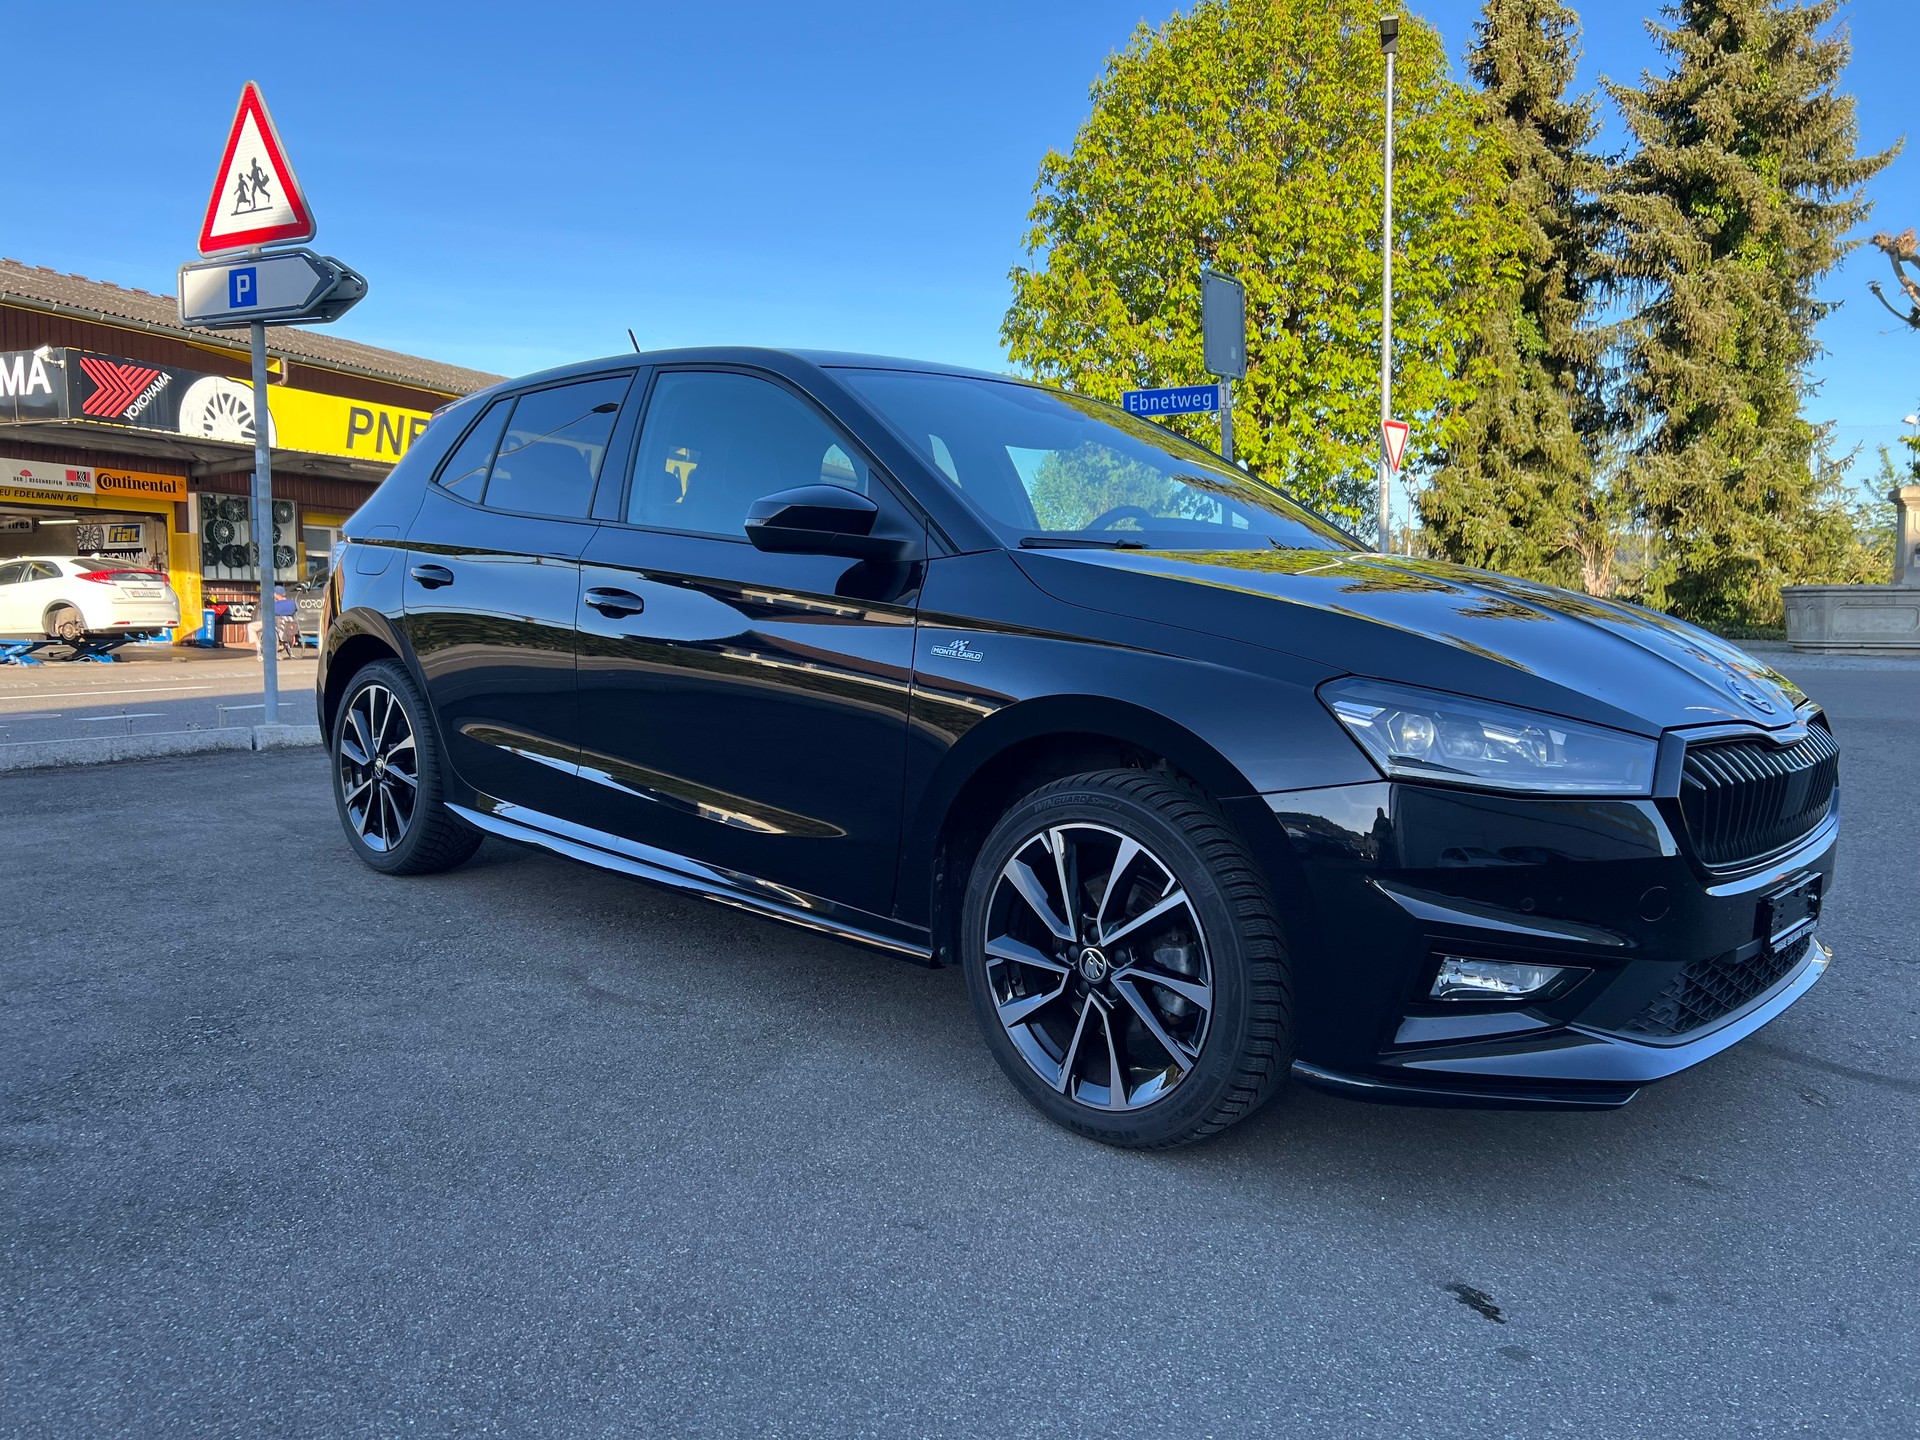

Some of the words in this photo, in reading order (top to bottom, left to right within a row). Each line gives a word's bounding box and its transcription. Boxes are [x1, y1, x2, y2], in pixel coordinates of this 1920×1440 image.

[236, 274, 250, 303] P
[0, 355, 52, 397] MA
[123, 371, 172, 421] YOKOHAMA
[1130, 392, 1212, 412] Ebnetweg
[97, 473, 177, 493] Continental
[14, 489, 64, 501] EDELMANN
[66, 494, 79, 502] AG
[933, 647, 957, 656] MONTE
[957, 651, 981, 660] CARLO
[1033, 794, 1089, 814] WINGUARD
[1072, 1121, 1138, 1139] NEXEN
